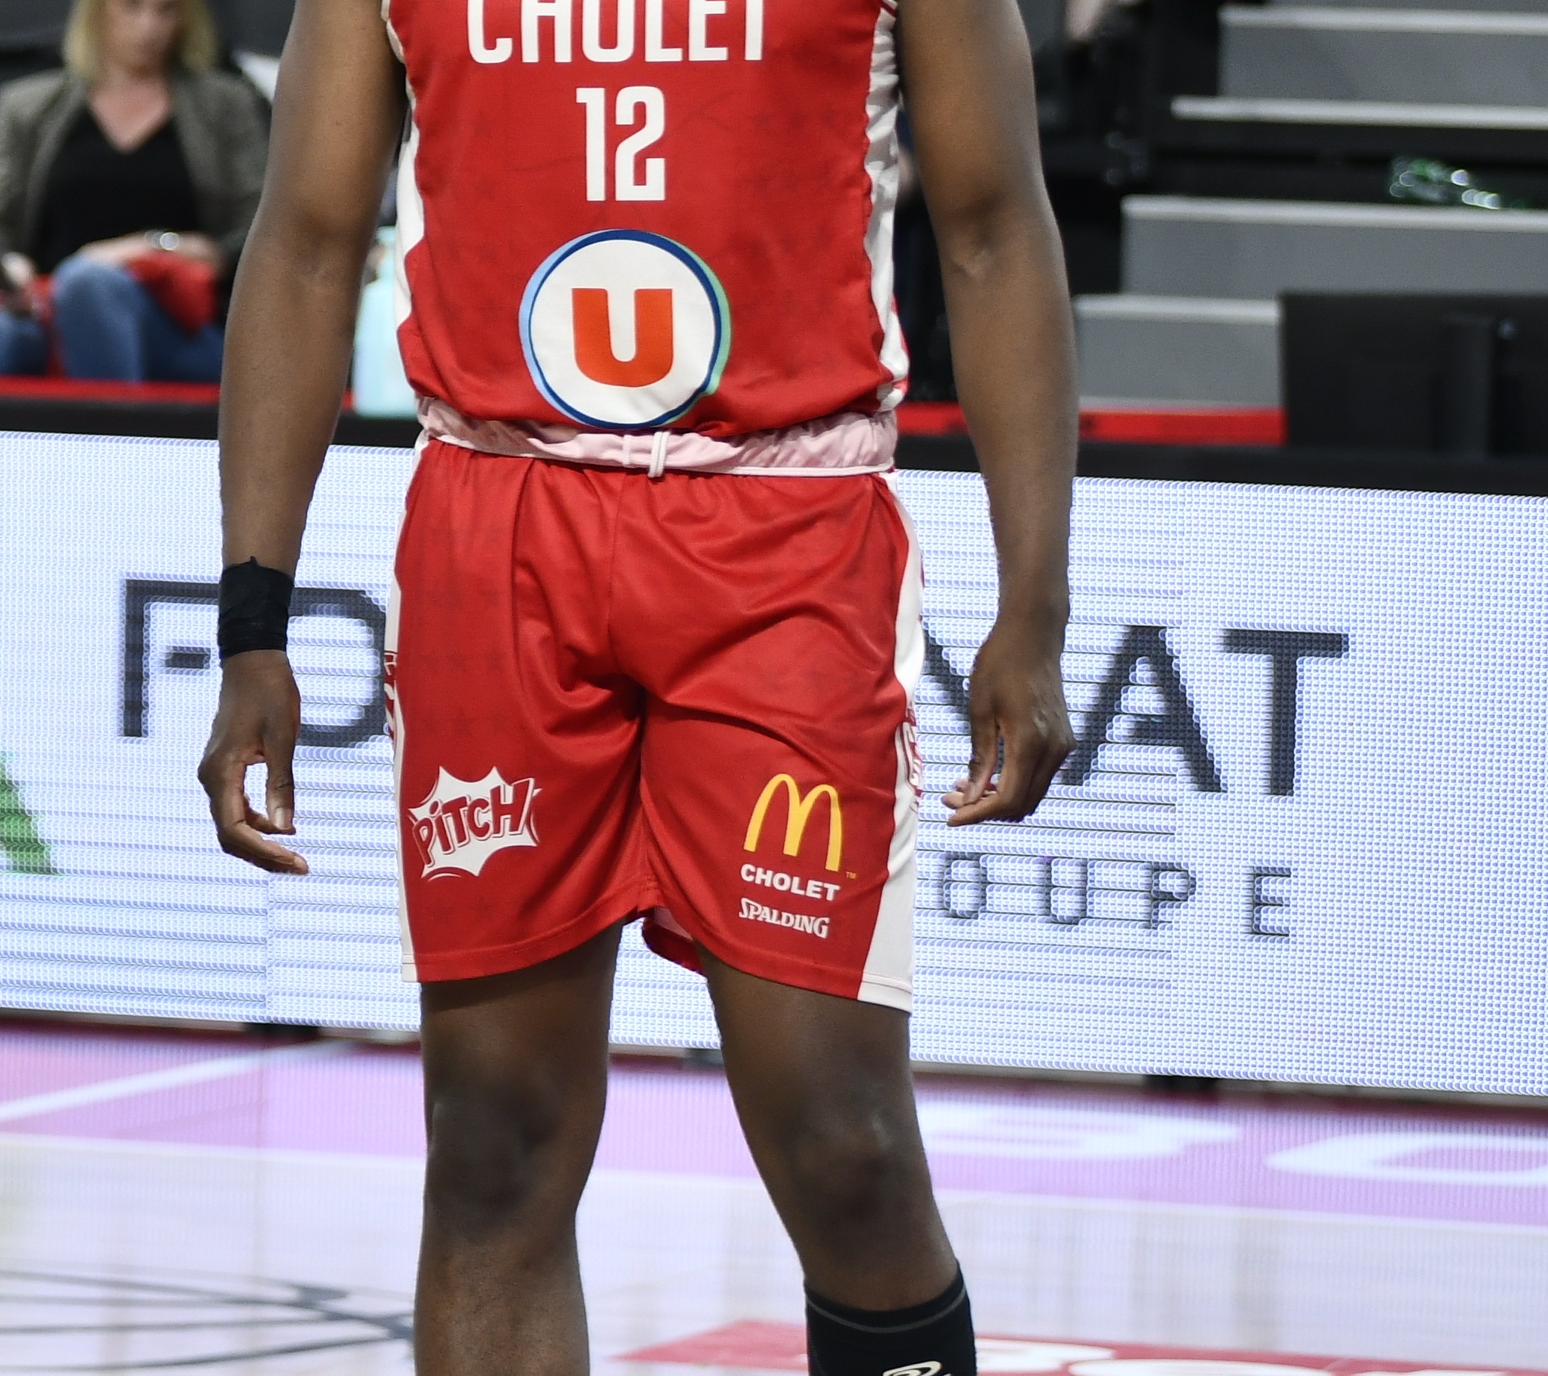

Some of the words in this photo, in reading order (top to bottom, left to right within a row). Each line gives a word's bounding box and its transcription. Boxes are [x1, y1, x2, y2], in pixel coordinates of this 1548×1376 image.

[576, 86, 666, 202] 12
[739, 863, 840, 902] CHOLET
[738, 896, 830, 939] SPALDING
